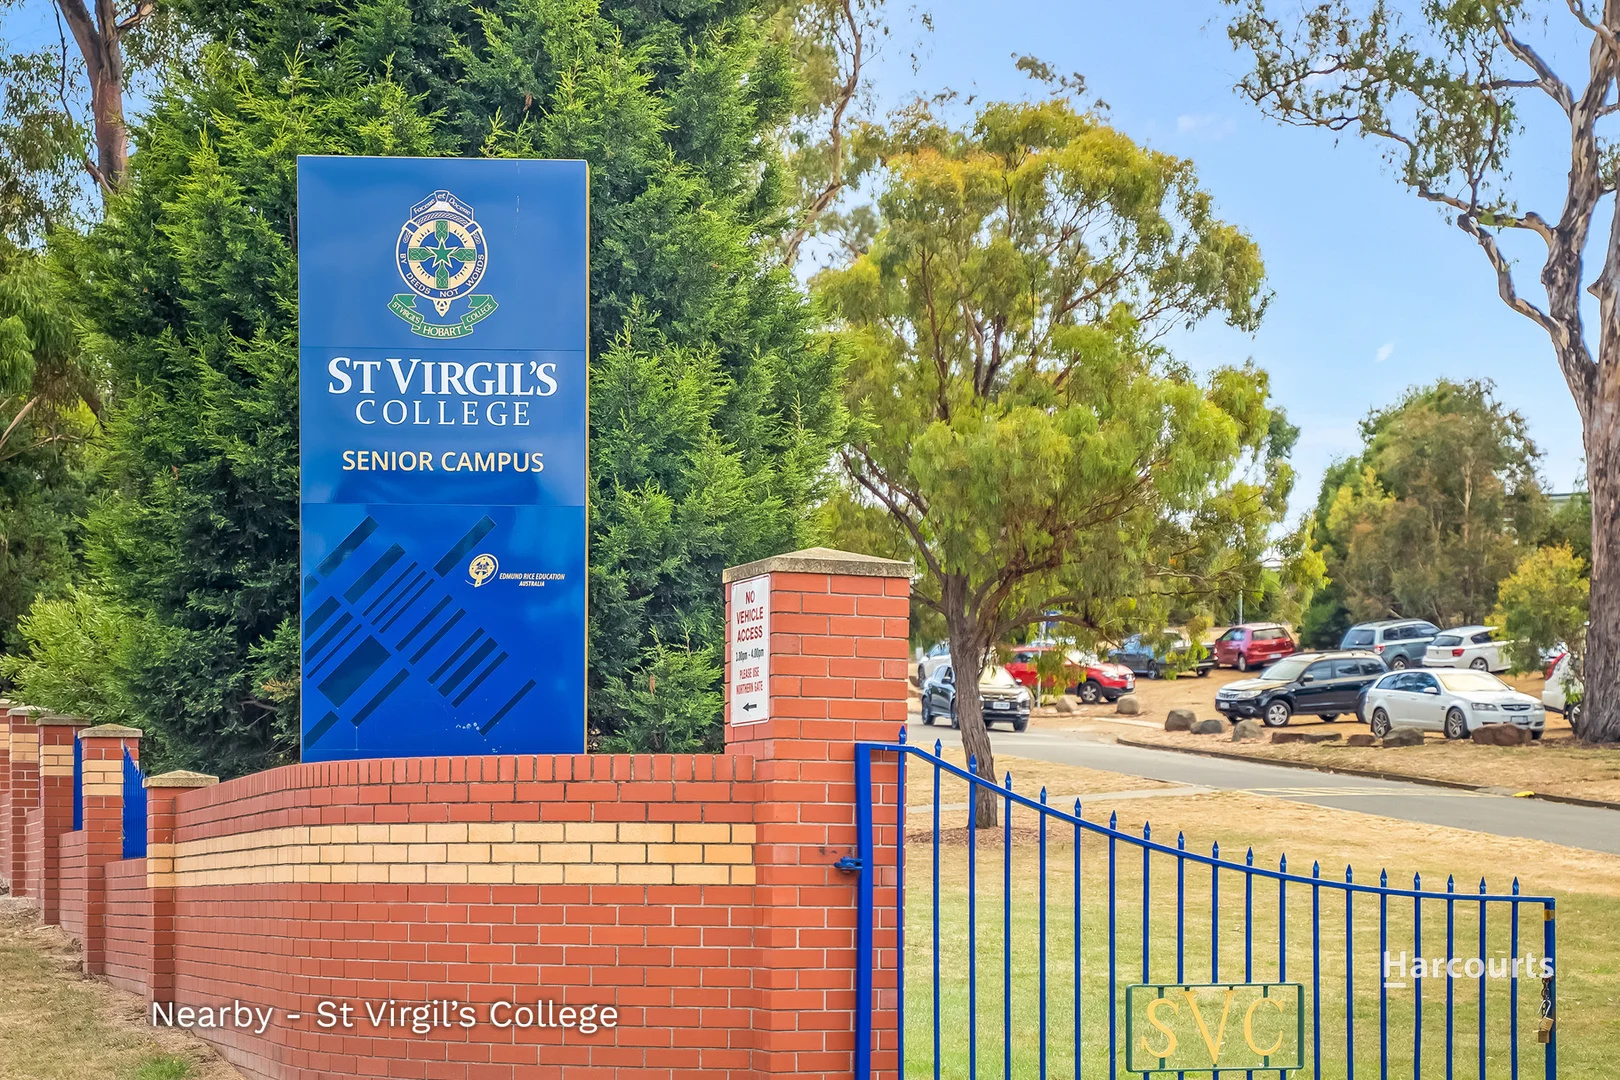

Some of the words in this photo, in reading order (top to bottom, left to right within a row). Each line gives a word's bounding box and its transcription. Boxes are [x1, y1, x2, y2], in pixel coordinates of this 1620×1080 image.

[399, 253, 407, 264] BY
[406, 272, 431, 295] DEEDS
[439, 289, 459, 298] NOT
[465, 254, 484, 287] WORDS
[392, 301, 401, 310] ST
[422, 325, 463, 337] HOBART
[465, 302, 493, 323] COLLEGE
[327, 357, 382, 395] ST
[386, 358, 558, 397] VIRGIL'S
[355, 399, 530, 426] COLLEGE
[342, 450, 434, 472] SENIOR
[441, 451, 545, 473] CAMPUS
[745, 590, 755, 605] NO
[736, 606, 764, 625] VEHICLE
[736, 625, 763, 643] ACCESS
[739, 668, 753, 681] PLEASE
[736, 683, 754, 696] NORTHERN
[754, 680, 764, 693] GATE
[1141, 989, 1284, 1065] SVC
